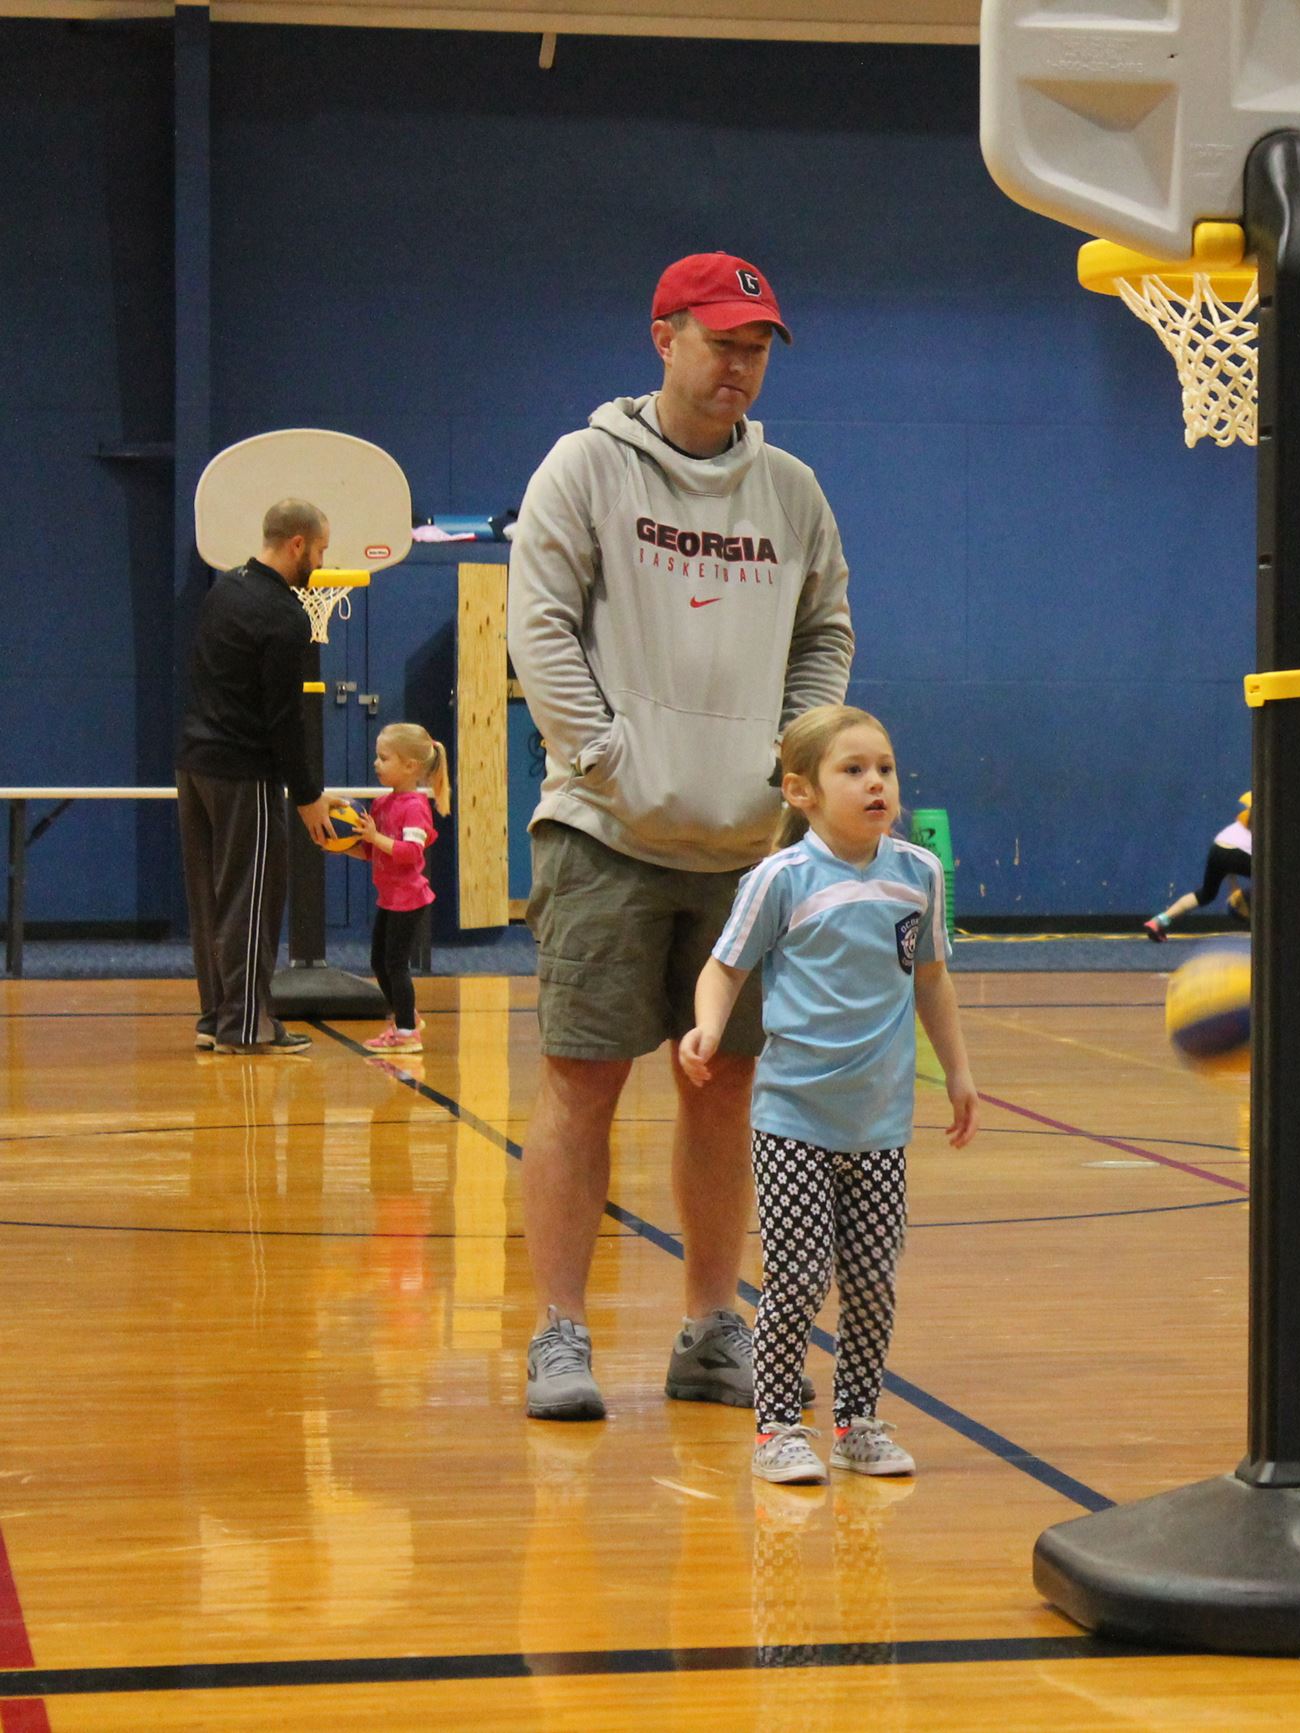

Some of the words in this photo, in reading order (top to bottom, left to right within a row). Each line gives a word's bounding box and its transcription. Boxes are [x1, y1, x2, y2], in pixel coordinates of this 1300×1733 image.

[736, 269, 761, 296] G
[636, 517, 778, 565] GEORGIA
[639, 547, 774, 585] BASKETBALL
